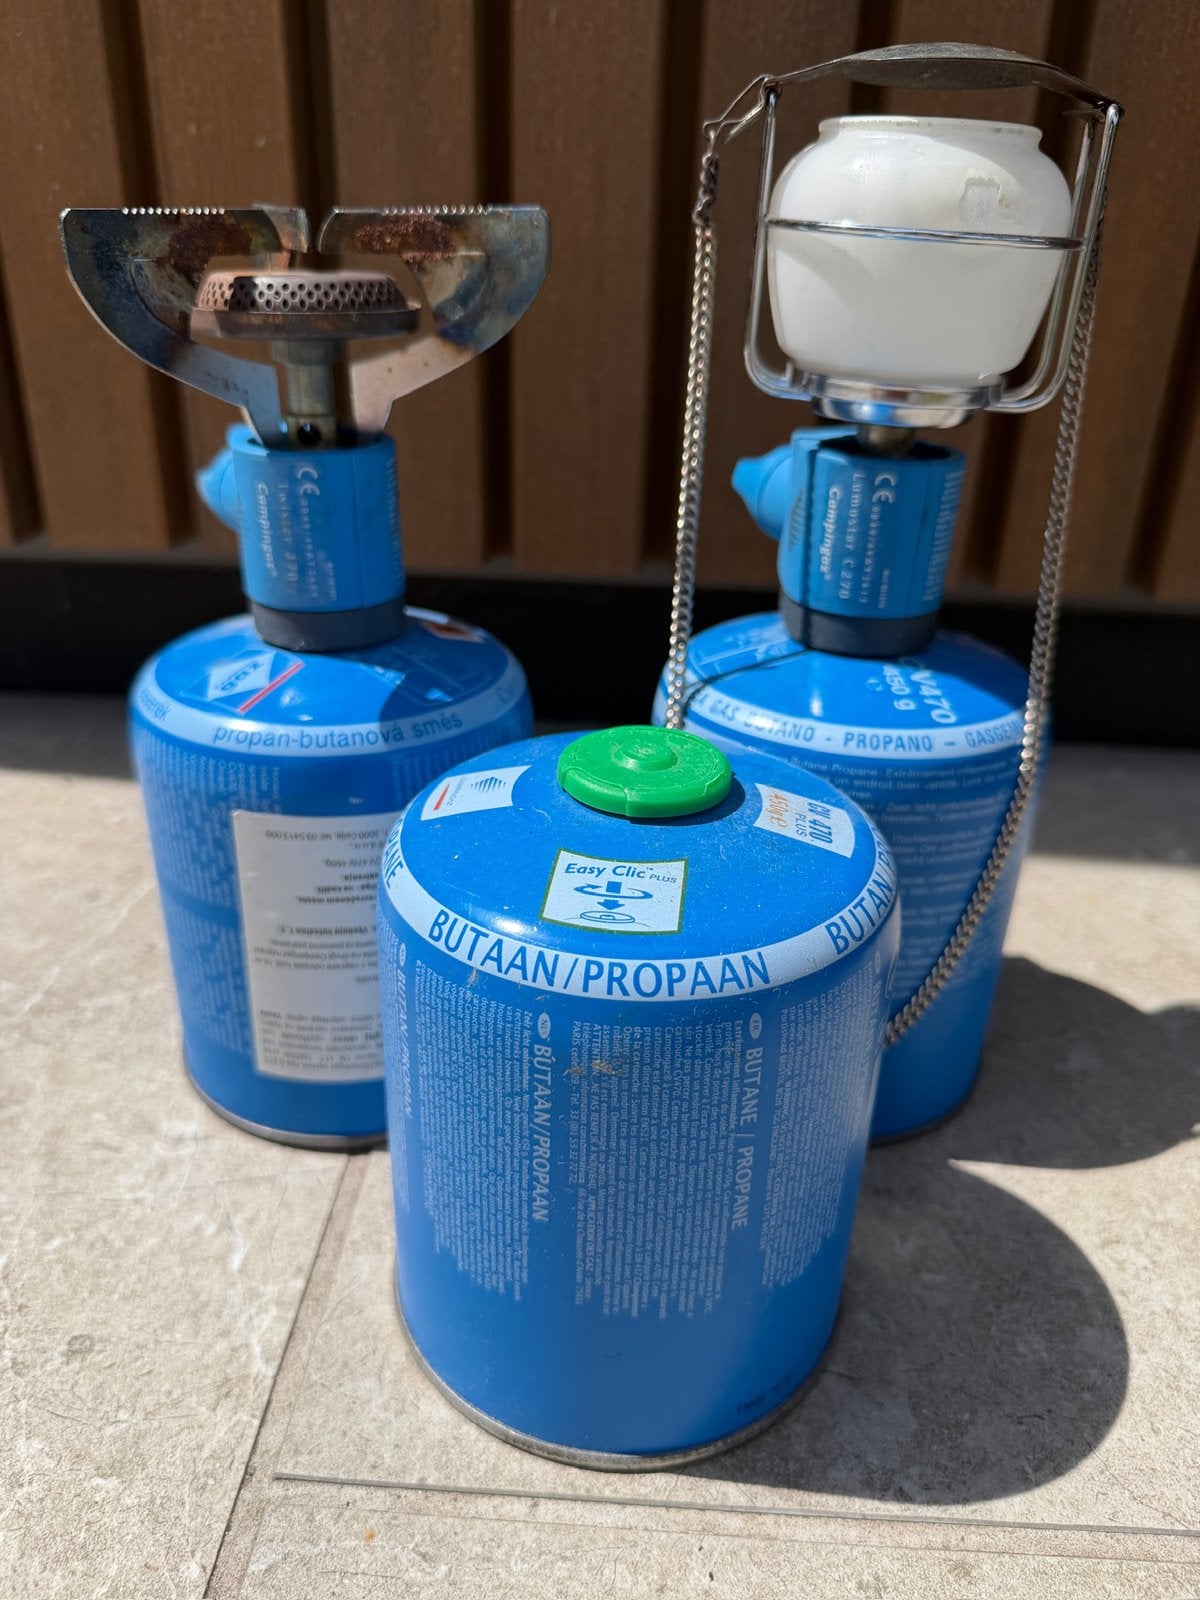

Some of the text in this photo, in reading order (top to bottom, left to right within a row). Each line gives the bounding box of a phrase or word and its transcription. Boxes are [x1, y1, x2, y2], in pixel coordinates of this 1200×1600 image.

[818, 484, 842, 576] Campingaz
[212, 714, 464, 750] propan-butanová směs
[842, 732, 933, 753] PROPANO
[794, 813, 808, 838] PLUS
[808, 818, 834, 844] 470
[563, 862, 606, 879] Easy
[650, 873, 678, 885] PLUS
[429, 909, 772, 999] BUTAAN/PROPAAN
[497, 1003, 506, 1034] houden
[633, 1026, 643, 1039] de
[571, 1020, 582, 1046] PARIS
[620, 1026, 634, 1057] Opérer
[642, 1026, 653, 1063] pression
[652, 1026, 663, 1068] cartouche
[674, 1025, 684, 1068] cartouche
[695, 1025, 704, 1057] stocker
[715, 1023, 724, 1046] Tenir
[685, 1045, 694, 1057] Ne
[631, 1051, 642, 1094] cartouche
[641, 1065, 653, 1093] directe
[682, 1059, 692, 1073] pas
[693, 1058, 703, 1079] dans
[703, 1057, 714, 1097] Conserver
[713, 1069, 722, 1079] de
[724, 1060, 732, 1074] des
[681, 1075, 691, 1099] percer
[739, 1047, 764, 1127] BUTANE
[630, 1099, 641, 1124] Suivre
[641, 1094, 651, 1116] selon
[661, 1089, 672, 1127] cartouche
[670, 1099, 680, 1121] Cette
[691, 1091, 702, 1120] endroit
[530, 1043, 552, 1221] BUTAAN/PROPAAN
[730, 1145, 755, 1231] PROPANE
